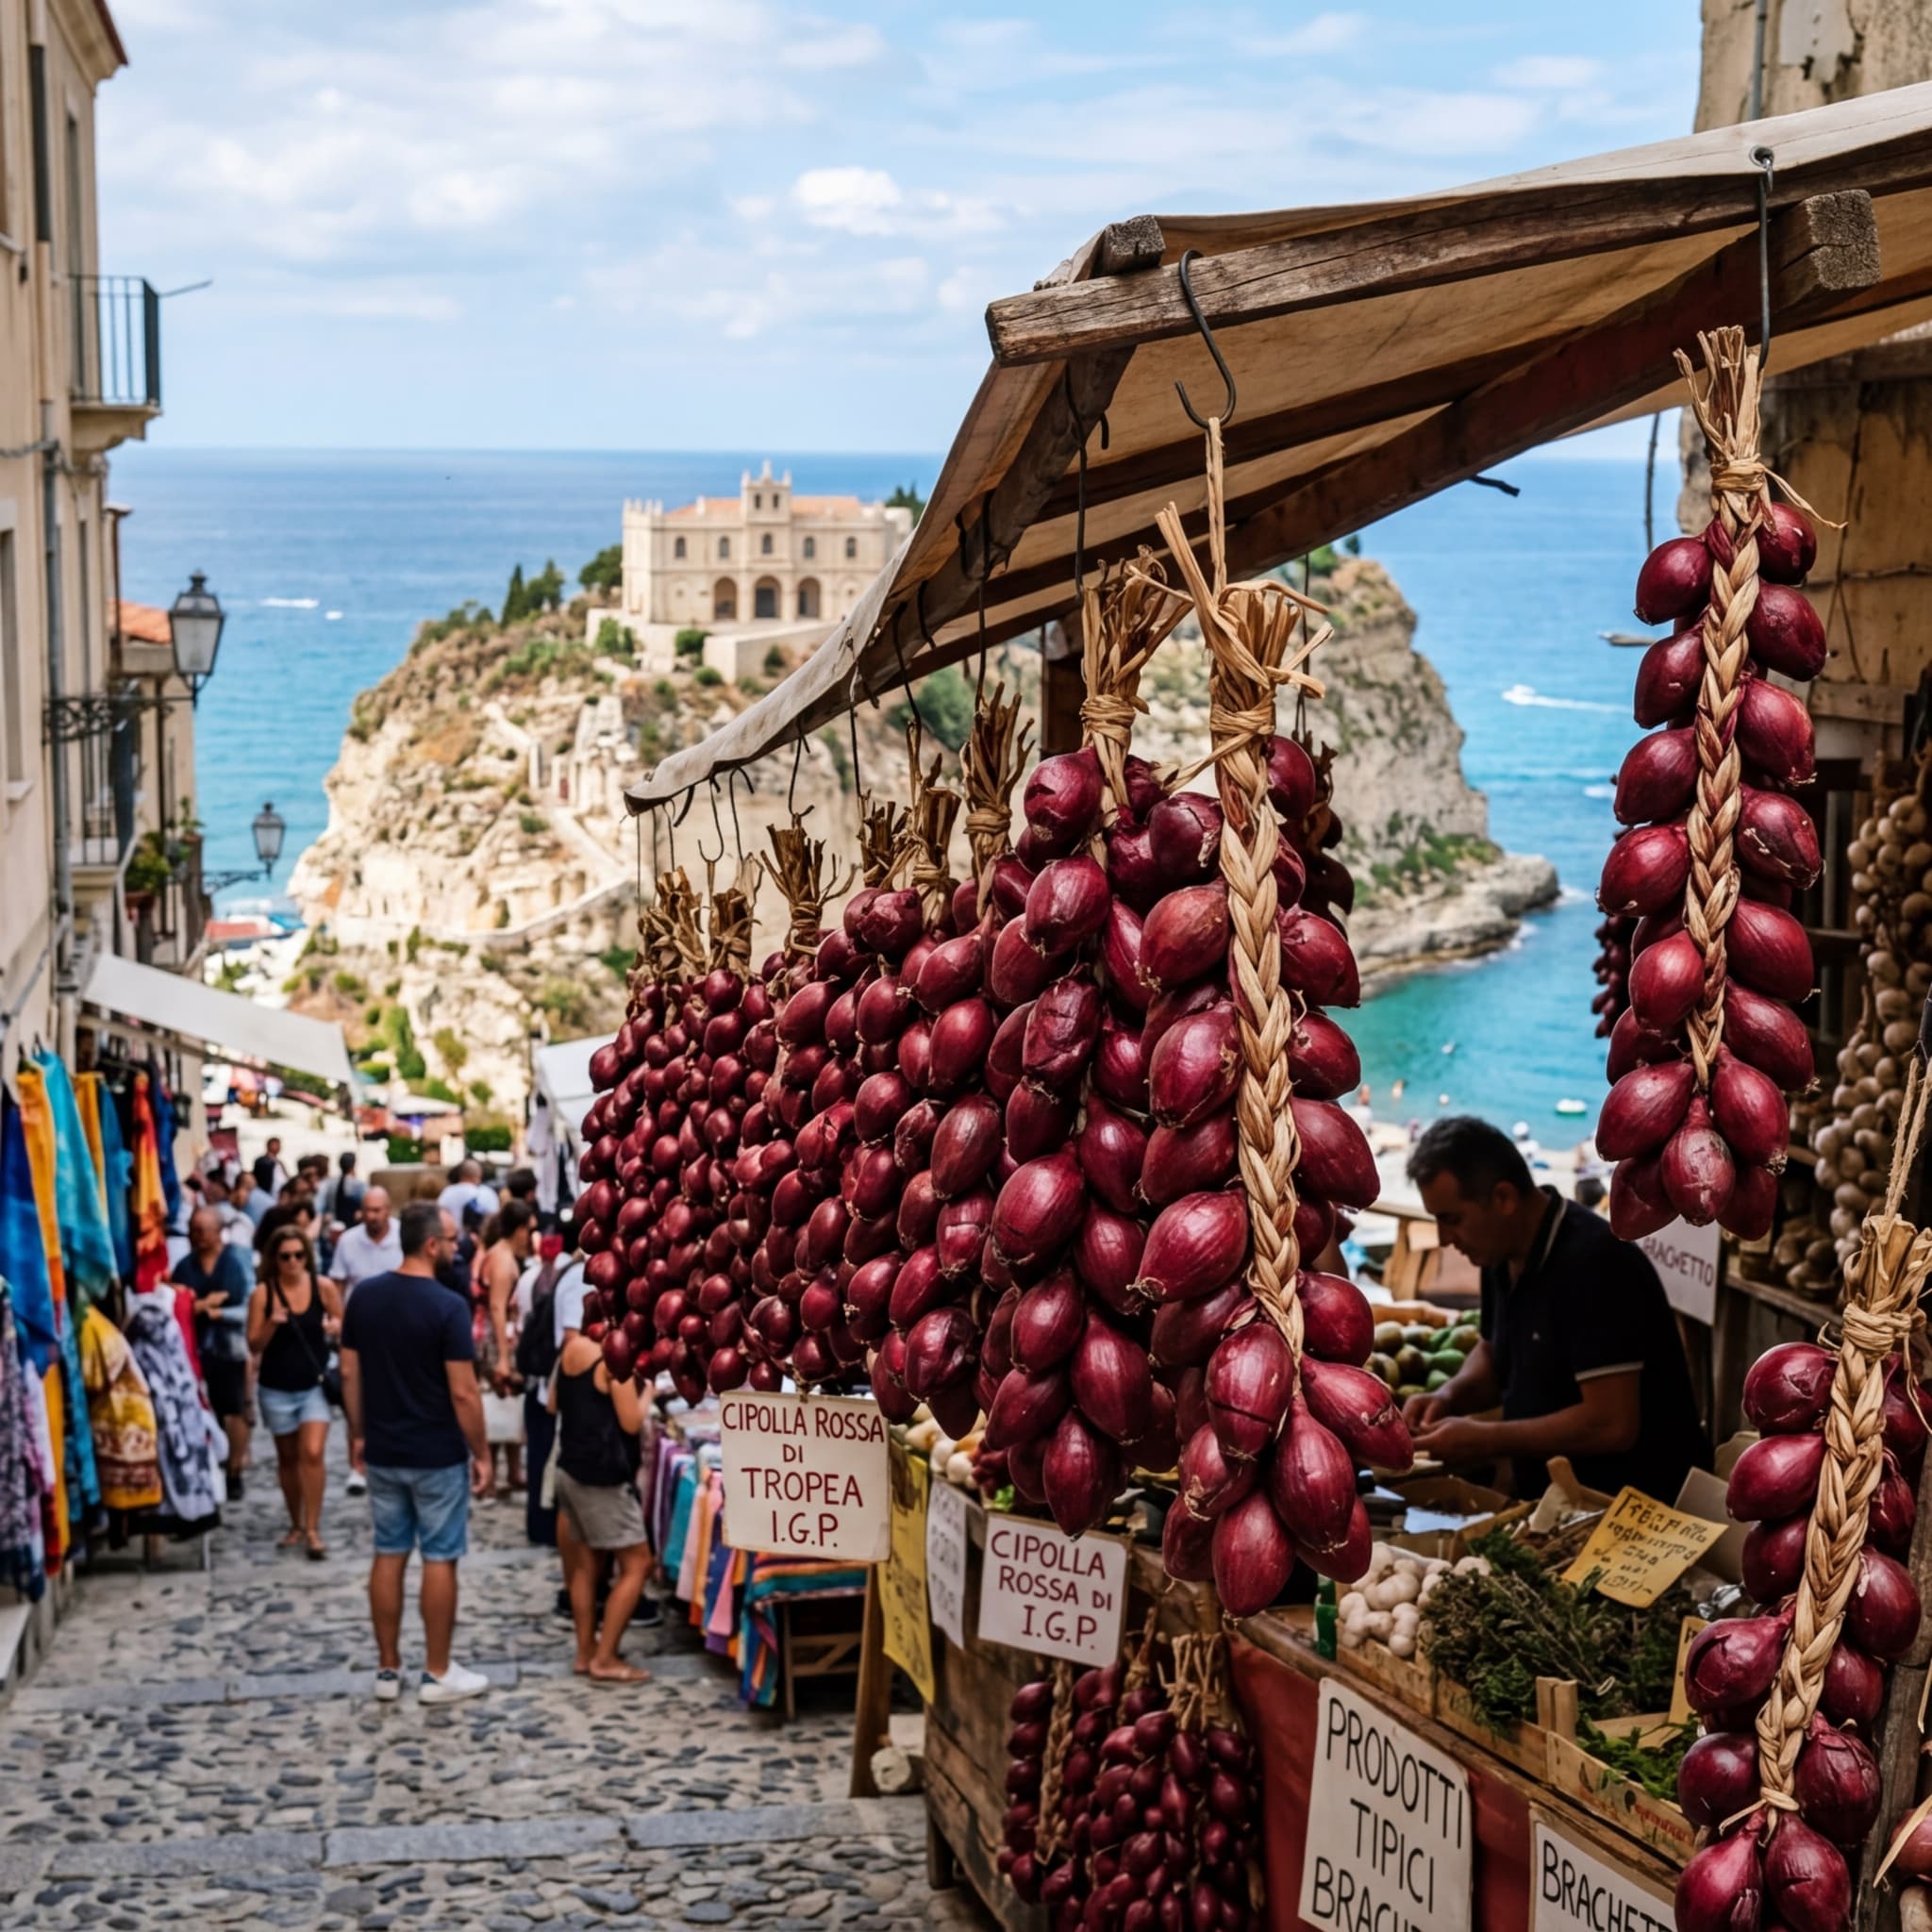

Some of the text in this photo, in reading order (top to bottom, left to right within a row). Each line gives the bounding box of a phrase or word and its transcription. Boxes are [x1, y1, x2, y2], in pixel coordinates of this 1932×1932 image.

[723, 1403, 885, 1443] CIPOLLA ROSSA
[783, 1443, 803, 1463] DI
[741, 1468, 863, 1507] TROPEA
[772, 1510, 839, 1548] I.G.P.
[991, 1530, 1106, 1580] CIPOLLA
[999, 1565, 1112, 1611] ROSSA DI
[1022, 1605, 1098, 1650] I.G.P.
[1326, 1697, 1463, 1849] PRODOTTI
[1350, 1797, 1434, 1914] TIPICI
